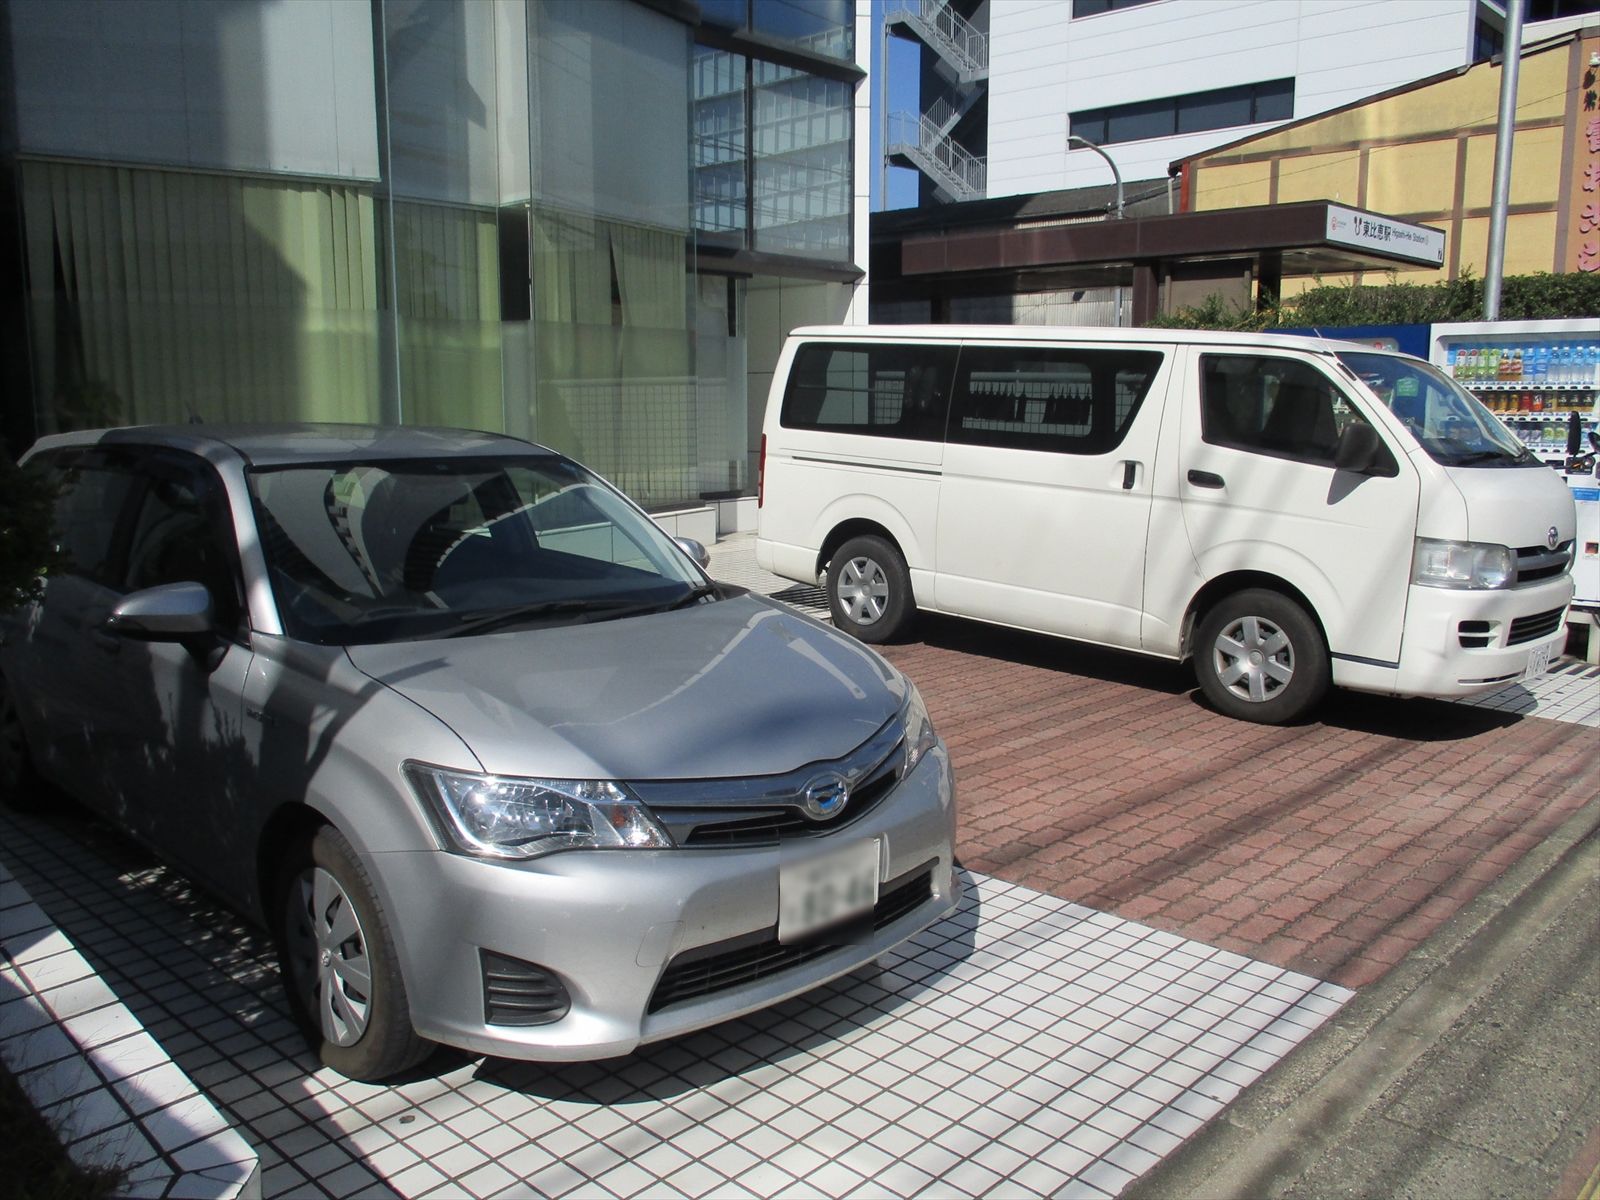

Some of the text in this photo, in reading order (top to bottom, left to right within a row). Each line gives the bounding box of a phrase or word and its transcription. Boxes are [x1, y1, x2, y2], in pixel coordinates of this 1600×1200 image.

[1363, 221, 1391, 241] 東比恵駅
[1412, 232, 1425, 244] Station
